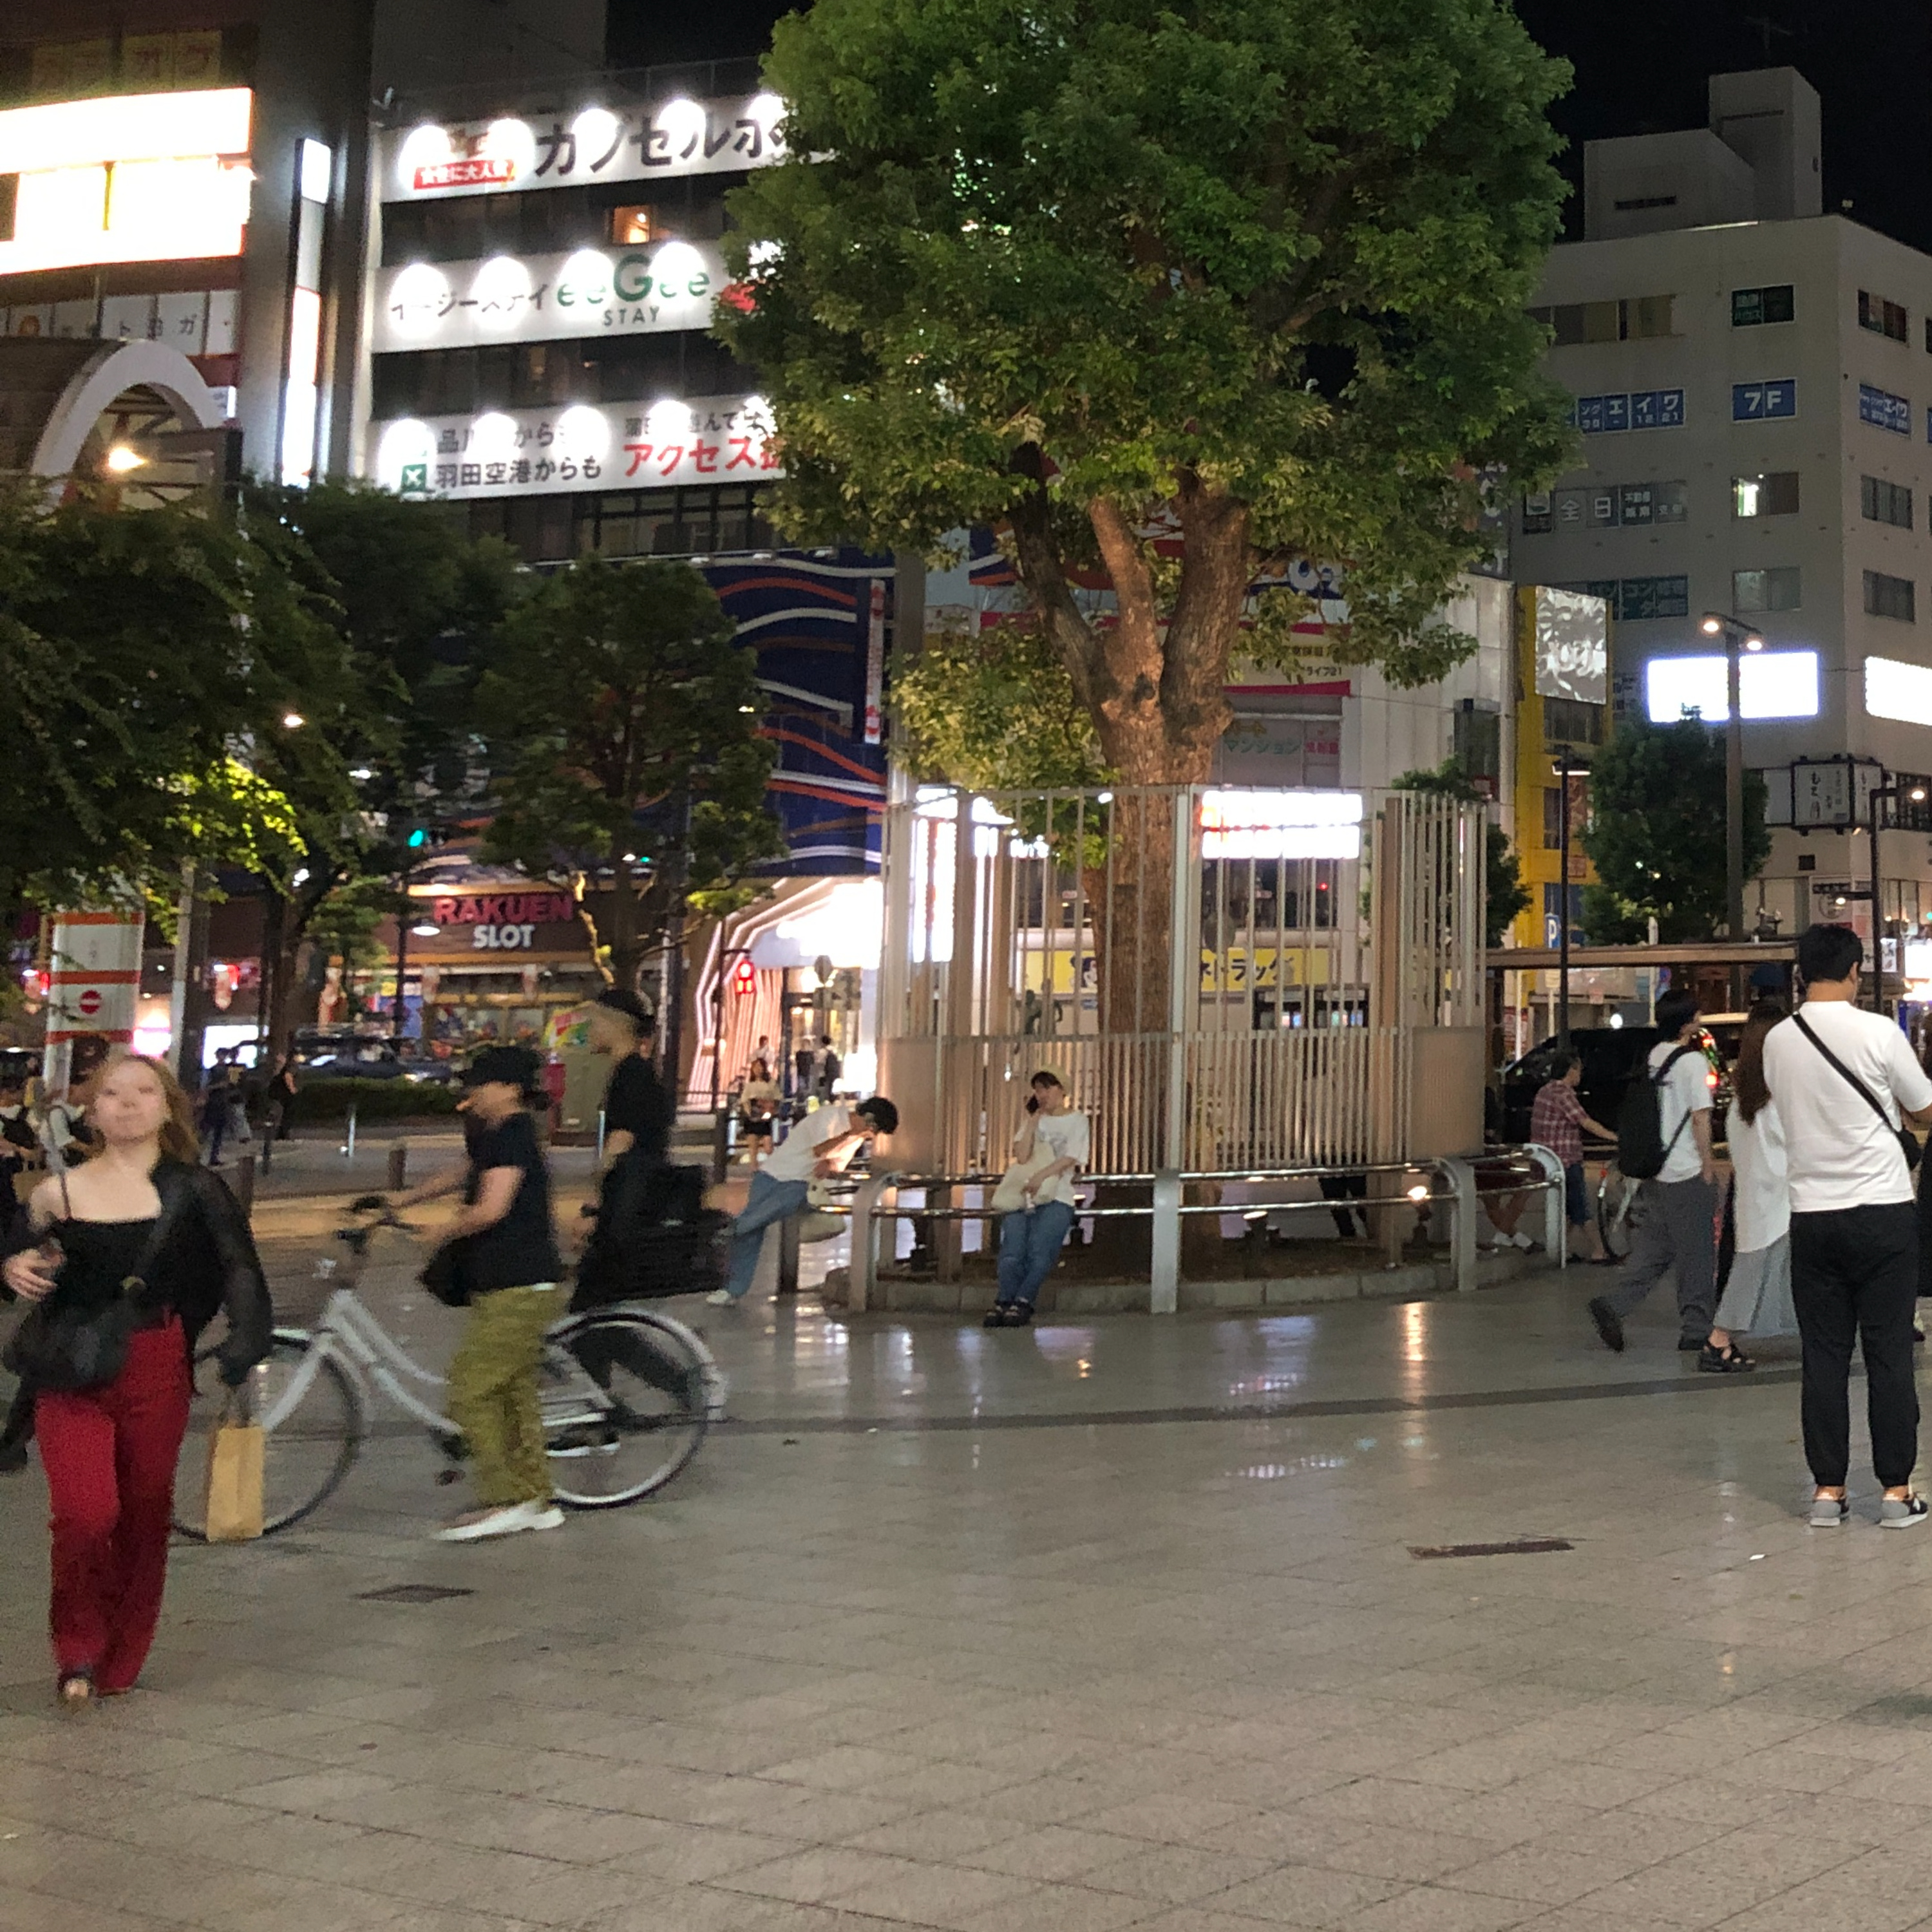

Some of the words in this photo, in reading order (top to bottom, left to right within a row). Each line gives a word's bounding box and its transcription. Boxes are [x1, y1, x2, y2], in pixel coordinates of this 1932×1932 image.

[603, 305, 659, 326] STAY
[1744, 390, 1781, 412] 7F
[435, 455, 601, 488] 羽田空港からも
[433, 895, 573, 925] RAKUEN
[472, 924, 536, 949] SLOT
[1548, 919, 1557, 949] P
